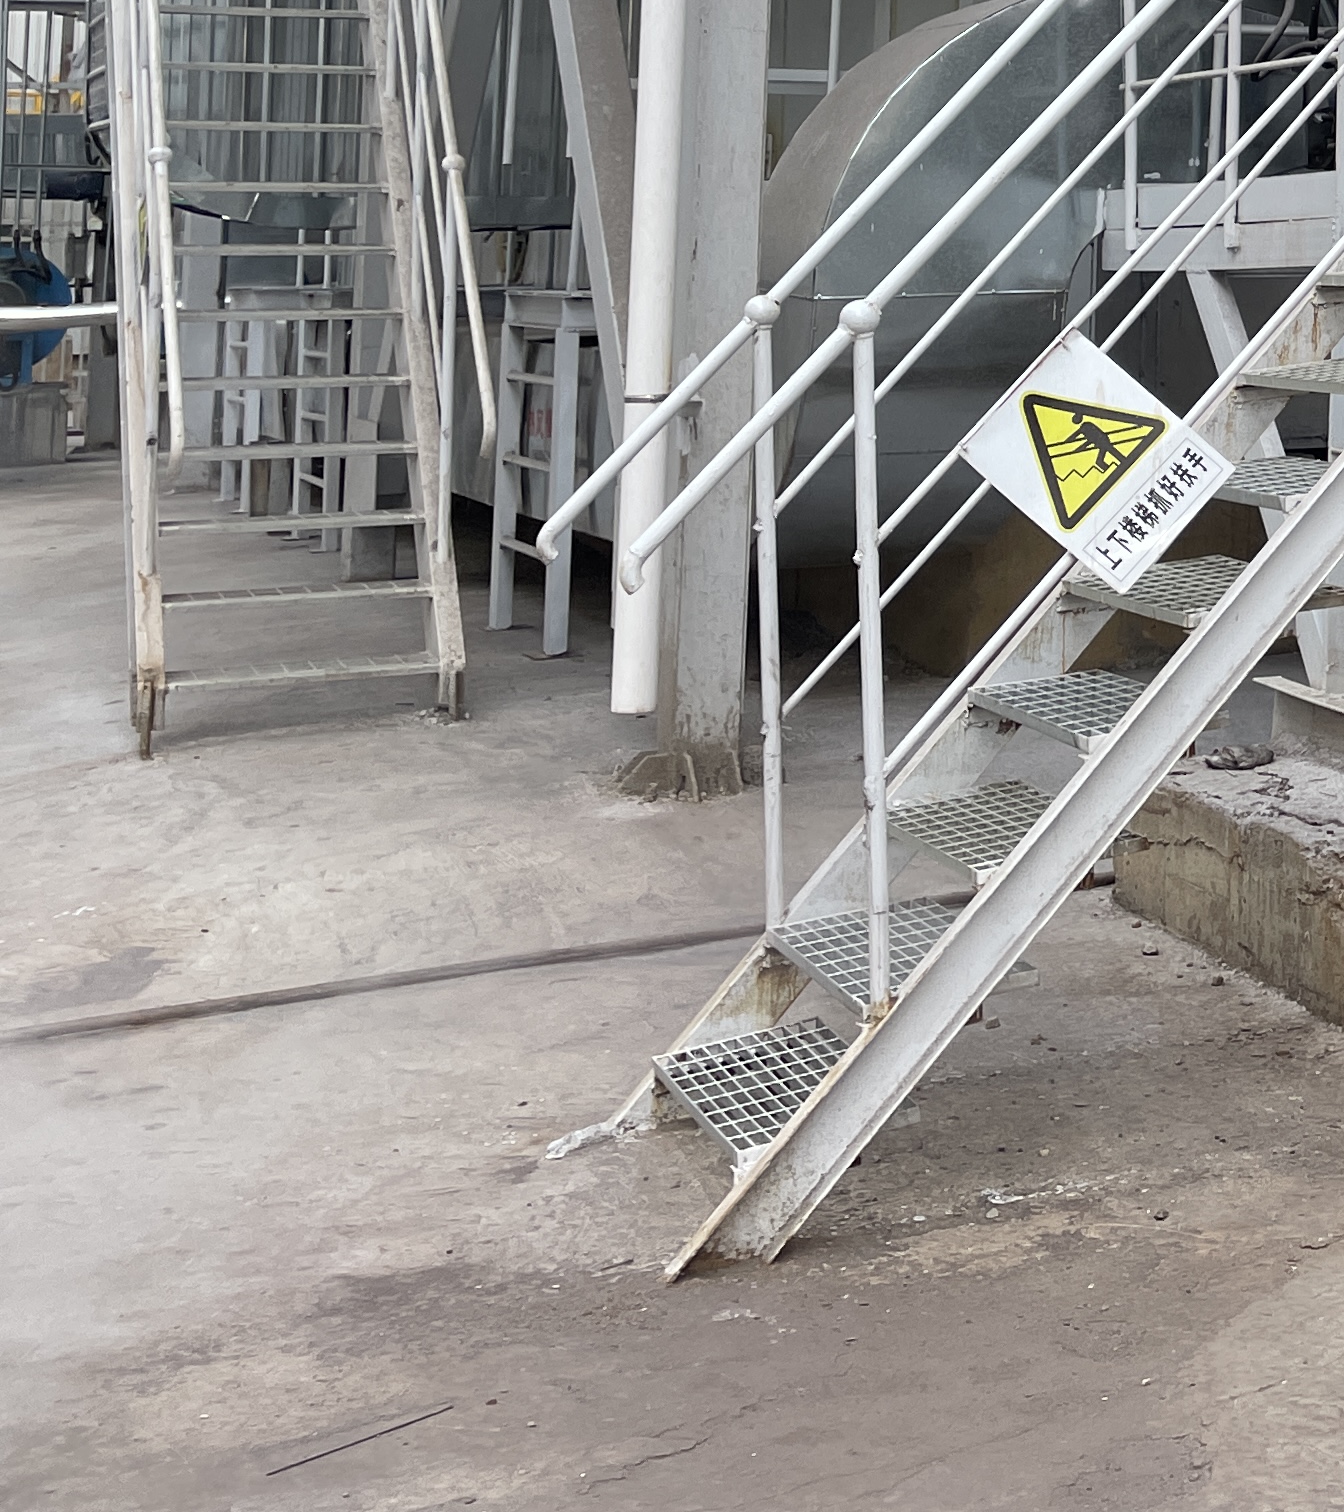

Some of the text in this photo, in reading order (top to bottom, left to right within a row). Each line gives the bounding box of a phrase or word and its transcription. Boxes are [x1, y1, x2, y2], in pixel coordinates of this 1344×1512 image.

[1095, 447, 1209, 571] 上下楼梯抓好扶手
